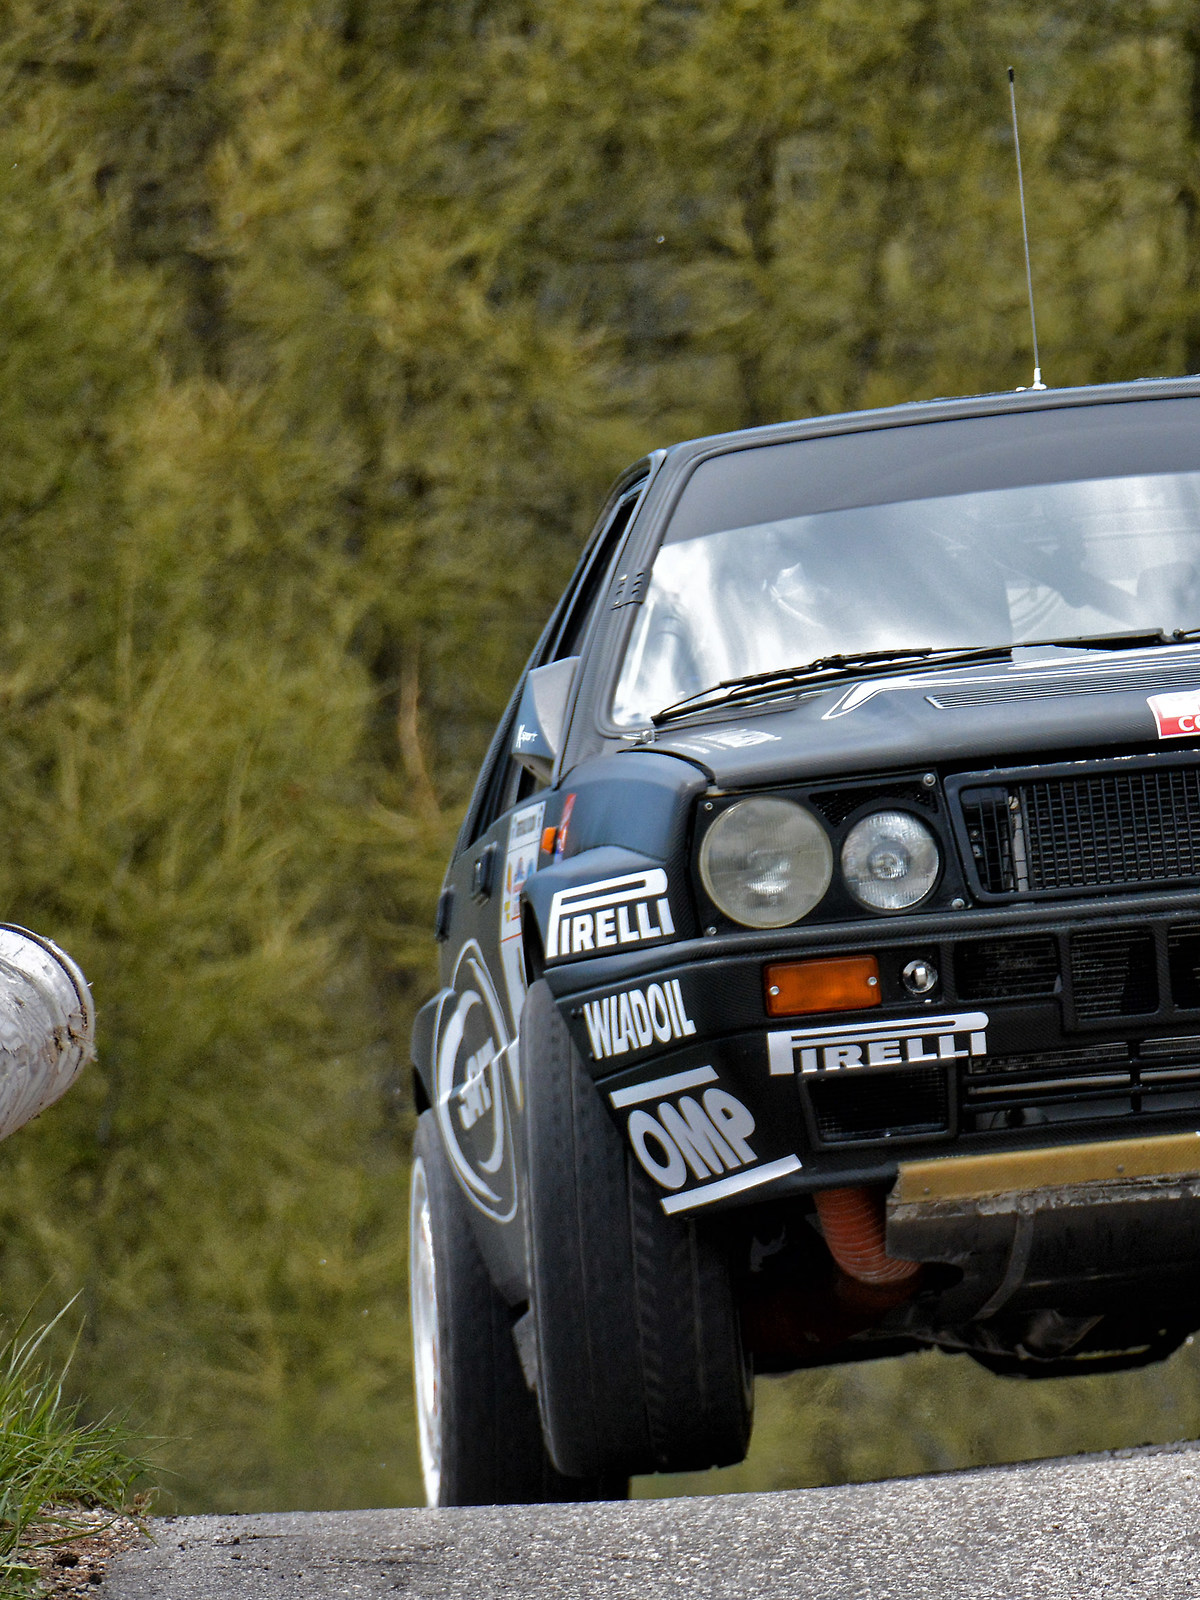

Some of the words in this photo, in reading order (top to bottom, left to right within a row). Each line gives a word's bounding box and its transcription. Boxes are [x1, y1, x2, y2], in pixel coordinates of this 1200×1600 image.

[546, 867, 676, 959] PIRELLI
[767, 1011, 990, 1076] PIRELLI
[627, 1087, 759, 1191] OMP
